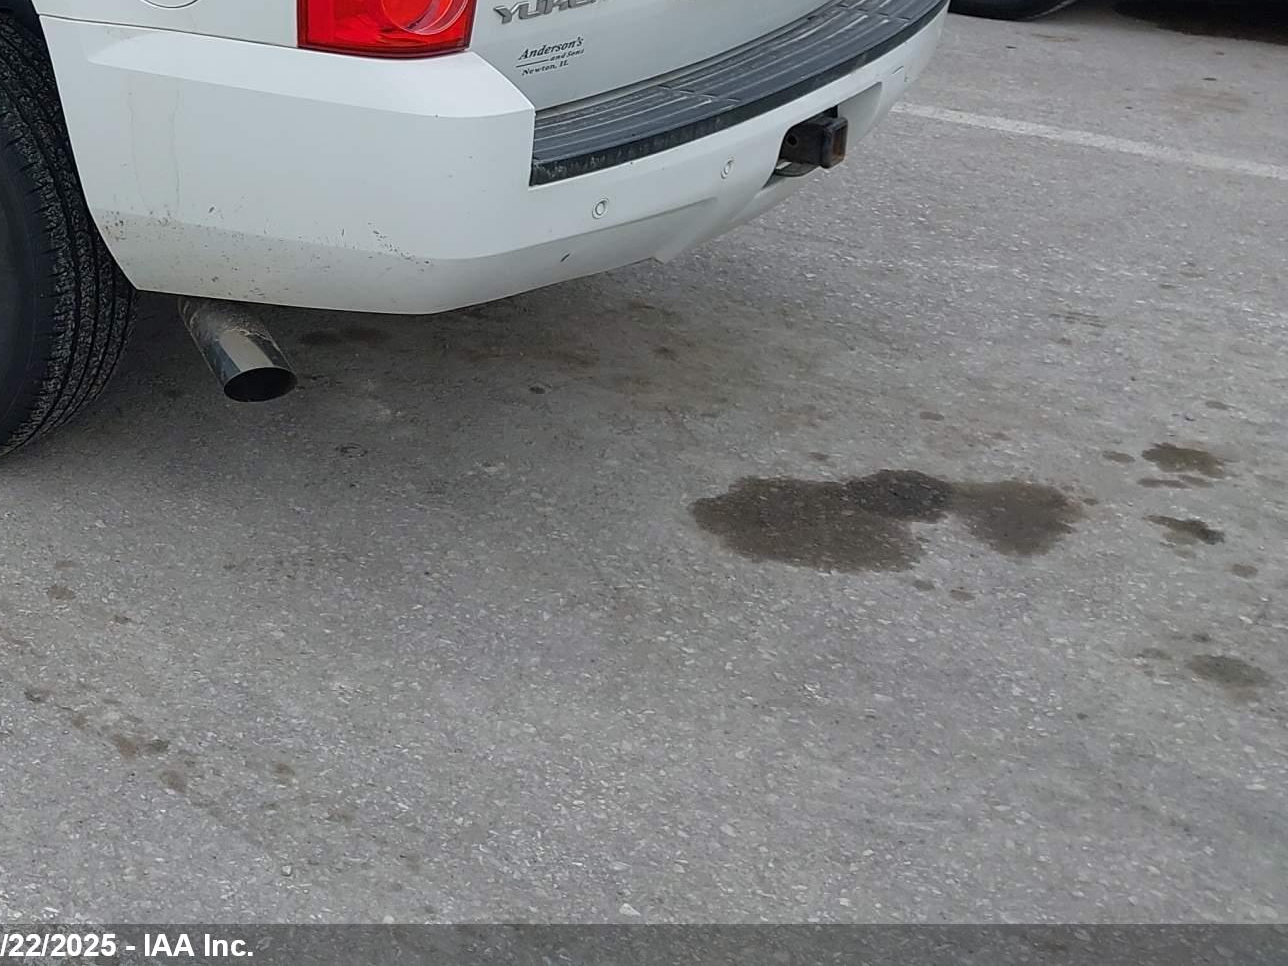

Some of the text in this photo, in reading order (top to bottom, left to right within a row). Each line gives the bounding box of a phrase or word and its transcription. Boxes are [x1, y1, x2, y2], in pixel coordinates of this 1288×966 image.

[518, 37, 584, 60] Anderson's
[549, 52, 566, 61] and
[521, 64, 558, 76] Newton,
